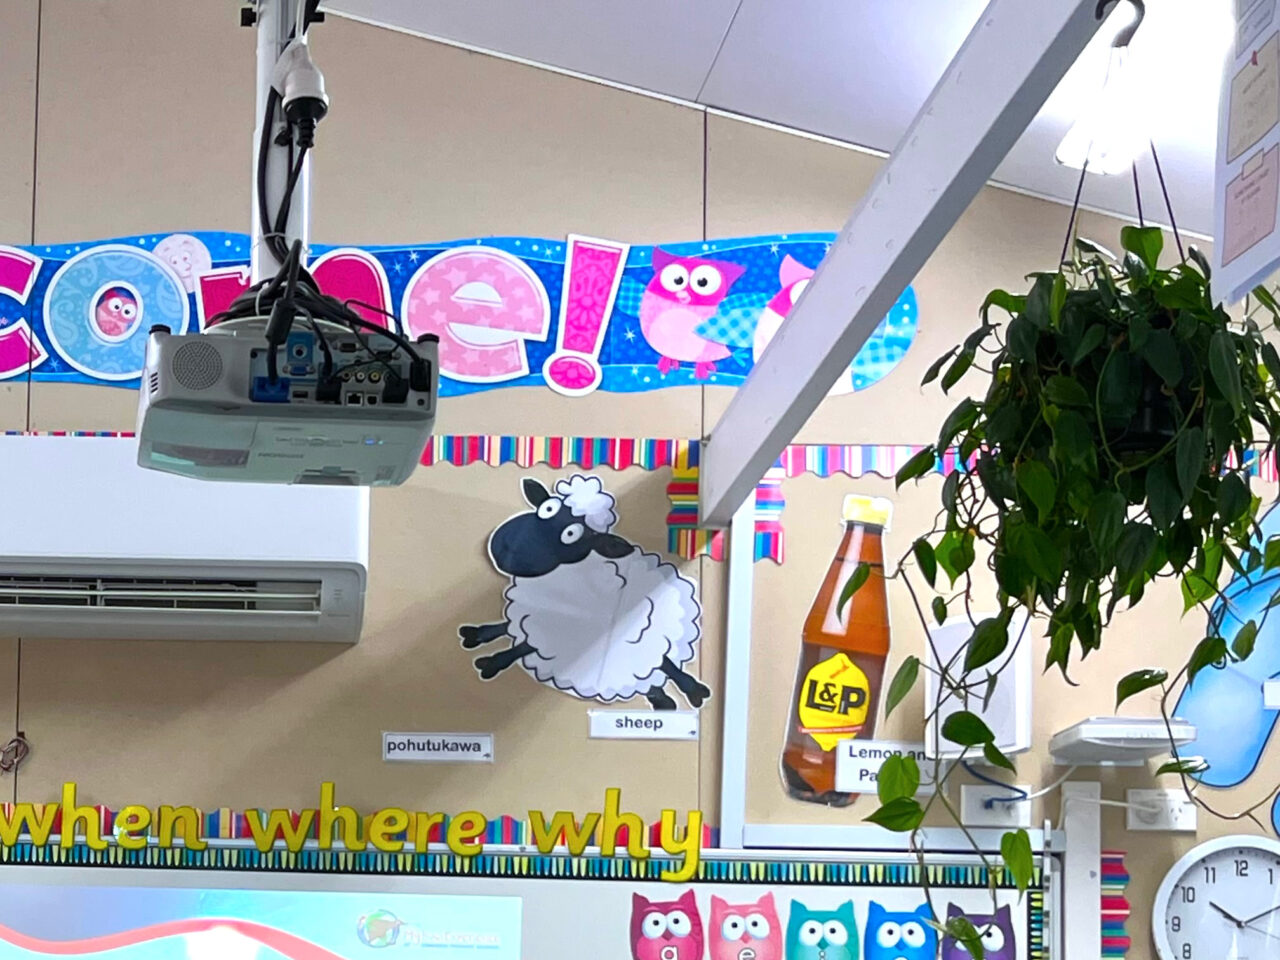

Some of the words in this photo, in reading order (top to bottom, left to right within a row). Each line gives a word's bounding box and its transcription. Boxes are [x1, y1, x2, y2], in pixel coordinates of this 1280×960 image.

[805, 679, 867, 715] L&P
[615, 715, 664, 731] sheep
[387, 738, 482, 755] pohutukawa
[848, 744, 903, 759] Lemon
[244, 782, 488, 858] where
[527, 788, 703, 882] why
[1204, 867, 1216, 884] 11
[1233, 860, 1249, 877] 12
[1181, 886, 1196, 903] 10
[1171, 915, 1181, 932] 9
[1182, 943, 1192, 960] 8
